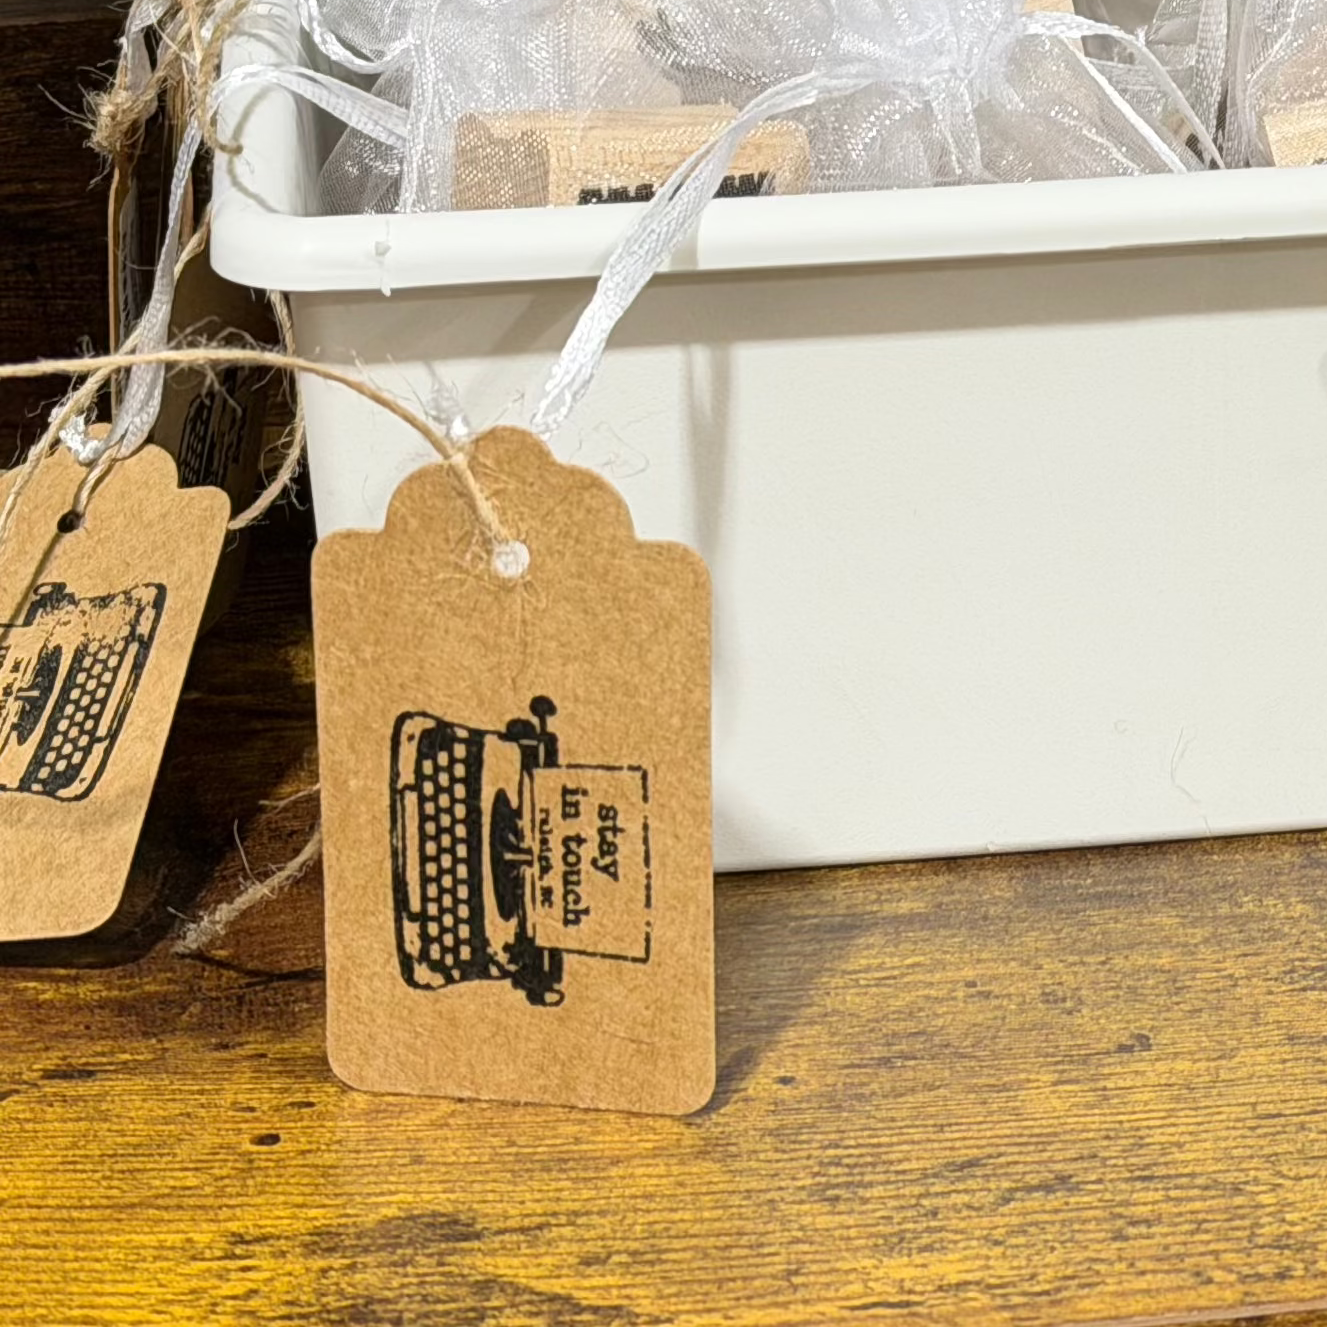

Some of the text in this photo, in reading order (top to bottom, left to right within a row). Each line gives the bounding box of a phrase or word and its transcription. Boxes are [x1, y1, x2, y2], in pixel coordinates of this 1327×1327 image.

[561, 784, 590, 928] in touch
[591, 803, 625, 882] stay
